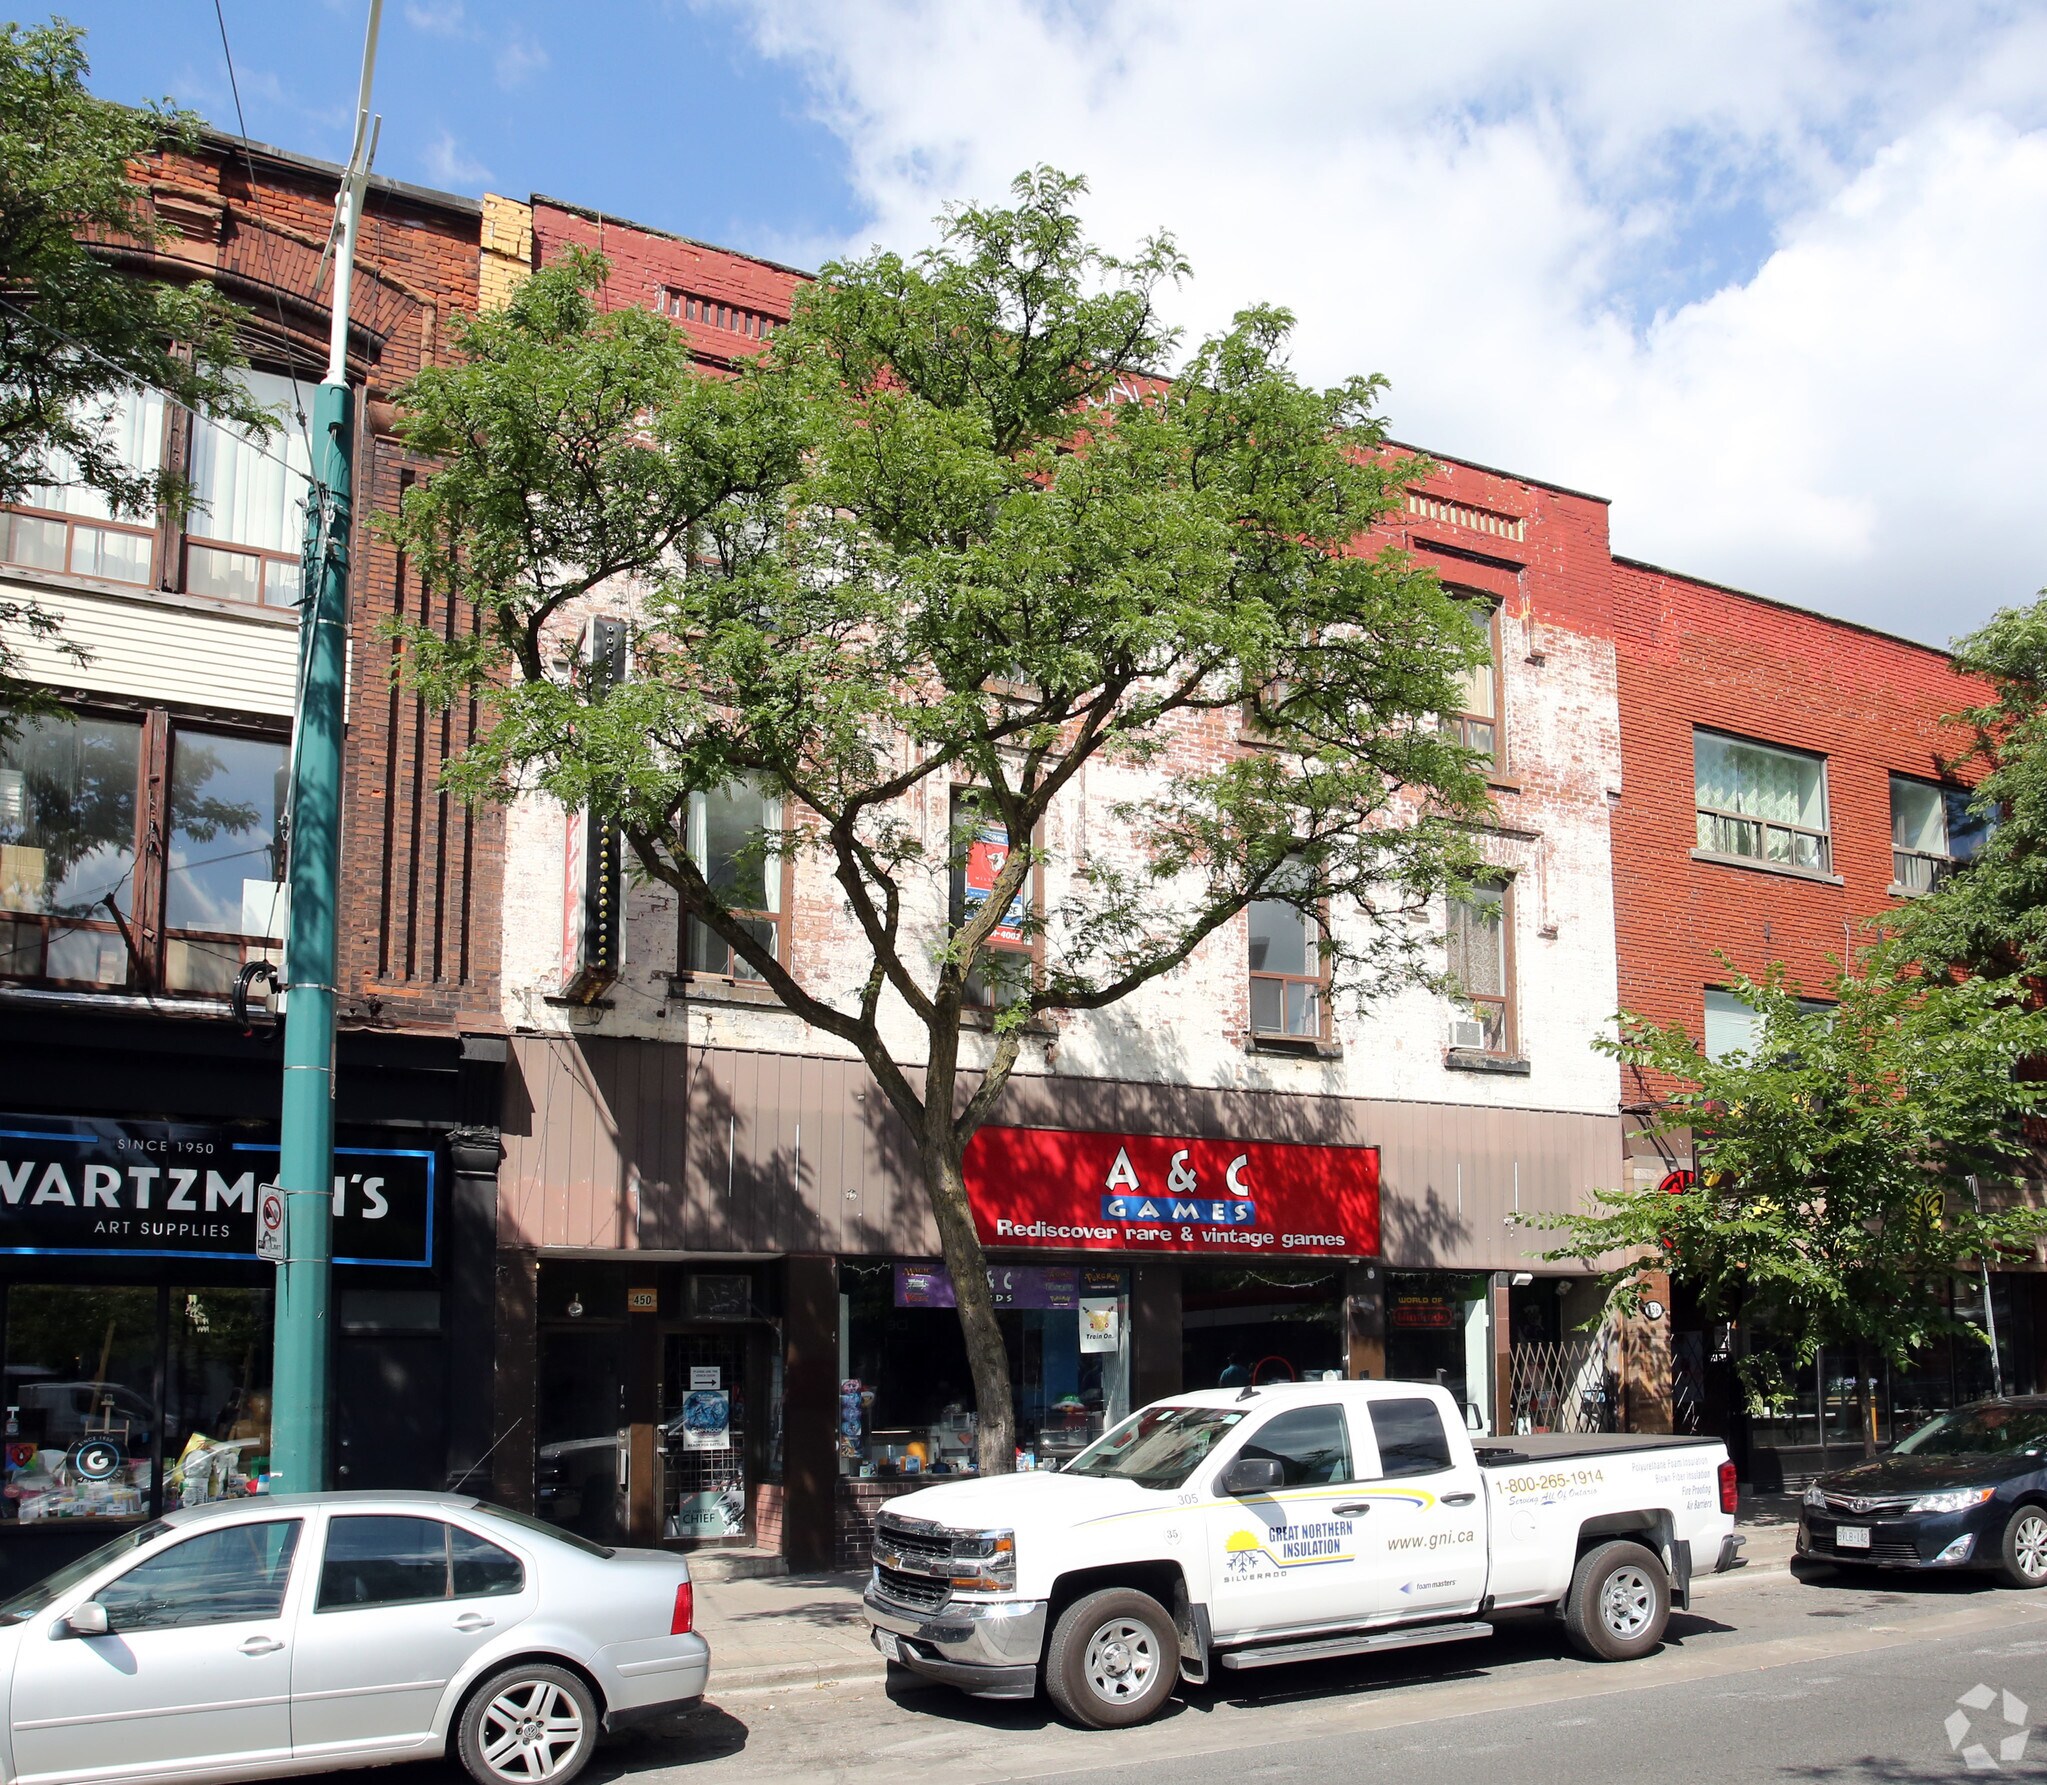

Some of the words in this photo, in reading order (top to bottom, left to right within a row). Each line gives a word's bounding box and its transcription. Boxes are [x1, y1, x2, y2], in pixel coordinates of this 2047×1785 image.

[117, 1138, 167, 1152] SINCE
[177, 1141, 214, 1154] 1950
[1105, 1145, 1140, 1192] A
[1167, 1149, 1197, 1193] &
[1226, 1154, 1249, 1196] C
[0, 1160, 389, 1220] WARTZM'S
[1107, 1199, 1248, 1221] GAMES
[94, 1221, 130, 1234] ART
[140, 1222, 230, 1238] SUPPLIES
[997, 1219, 1118, 1240] Rediscover
[1125, 1228, 1172, 1241] rare
[1180, 1229, 1194, 1242] &
[1201, 1229, 1275, 1246] vintage
[1282, 1233, 1346, 1248] games
[633, 1295, 651, 1305] 450
[1631, 1461, 1666, 1472] Polyurethane
[1667, 1459, 1682, 1468] Foam
[1495, 1469, 1604, 1495] 1-800-265-1914
[1682, 1486, 1692, 1496] Fire
[1692, 1484, 1712, 1495] Proofing
[1177, 1493, 1199, 1506] 305
[1509, 1495, 1540, 1506] Serving
[1541, 1493, 1556, 1503] All
[1556, 1490, 1567, 1502] Of
[1568, 1488, 1598, 1498] Ontario
[1694, 1500, 1713, 1510] Barriers
[682, 1513, 715, 1524] CHIEF
[1166, 1529, 1178, 1539] 35
[1269, 1525, 1299, 1543] GREAT
[1302, 1520, 1353, 1539] NORTHERN
[1387, 1529, 1474, 1551] www.gni.ca
[1283, 1538, 1340, 1559] INSULATION
[1224, 1570, 1287, 1583] SILVERADO
[1432, 1579, 1456, 1588] masters
